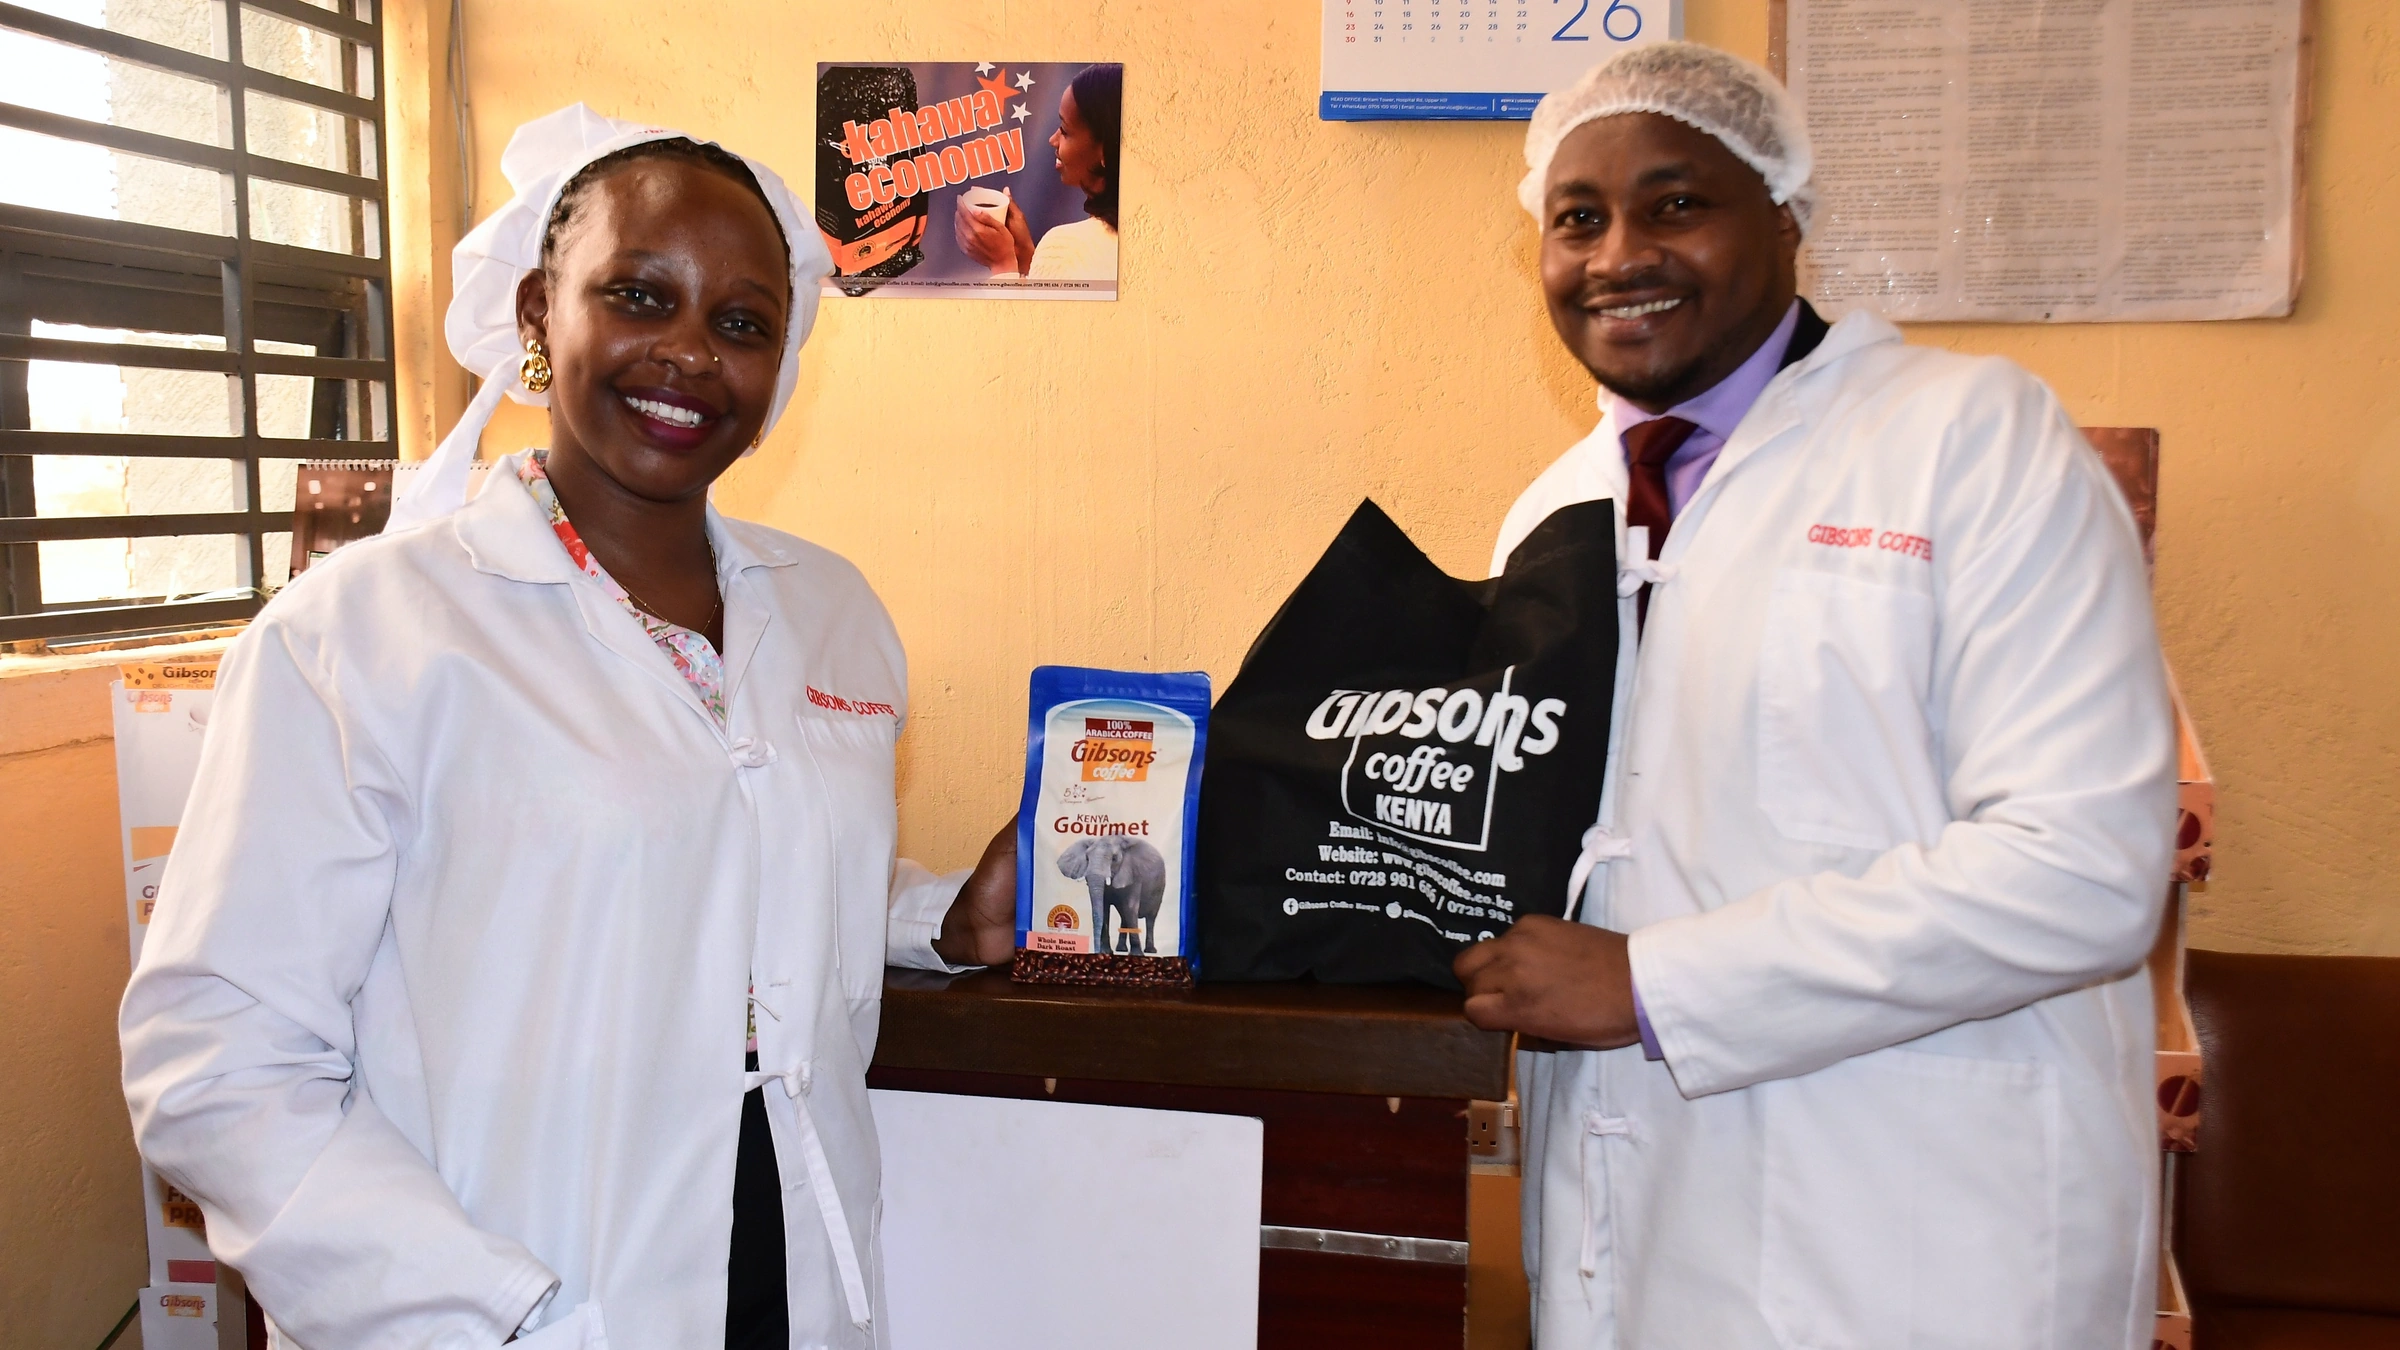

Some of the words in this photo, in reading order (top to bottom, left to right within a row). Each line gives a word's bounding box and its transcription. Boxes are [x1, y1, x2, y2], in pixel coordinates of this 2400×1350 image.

[1552, 0, 1642, 41] 26
[843, 89, 1002, 166] kahawa
[844, 127, 1026, 211] economy
[854, 201, 894, 229] kahawa
[874, 198, 911, 228] economy
[1878, 531, 1932, 562] COFFE
[162, 666, 217, 678] Gibson
[1086, 729, 1121, 737] ARABICA
[1122, 731, 1153, 739] COFFEE
[1106, 721, 1132, 730] 100%
[1071, 739, 1157, 768] Gibsons
[1093, 763, 1135, 780] coffee
[1364, 745, 1474, 793] coffee
[1054, 816, 1149, 836] Gourmet
[1077, 814, 1109, 822] KENYA
[1376, 794, 1451, 835] KENYA
[1329, 821, 1374, 840] Email:
[1318, 845, 1379, 864] Website:
[1285, 868, 1345, 884] Contact:
[1349, 870, 1386, 886] 0728
[1390, 872, 1416, 889] 981
[1447, 900, 1484, 917] 0728
[1488, 909, 1514, 924] 981
[160, 1295, 206, 1310] Gibsons
